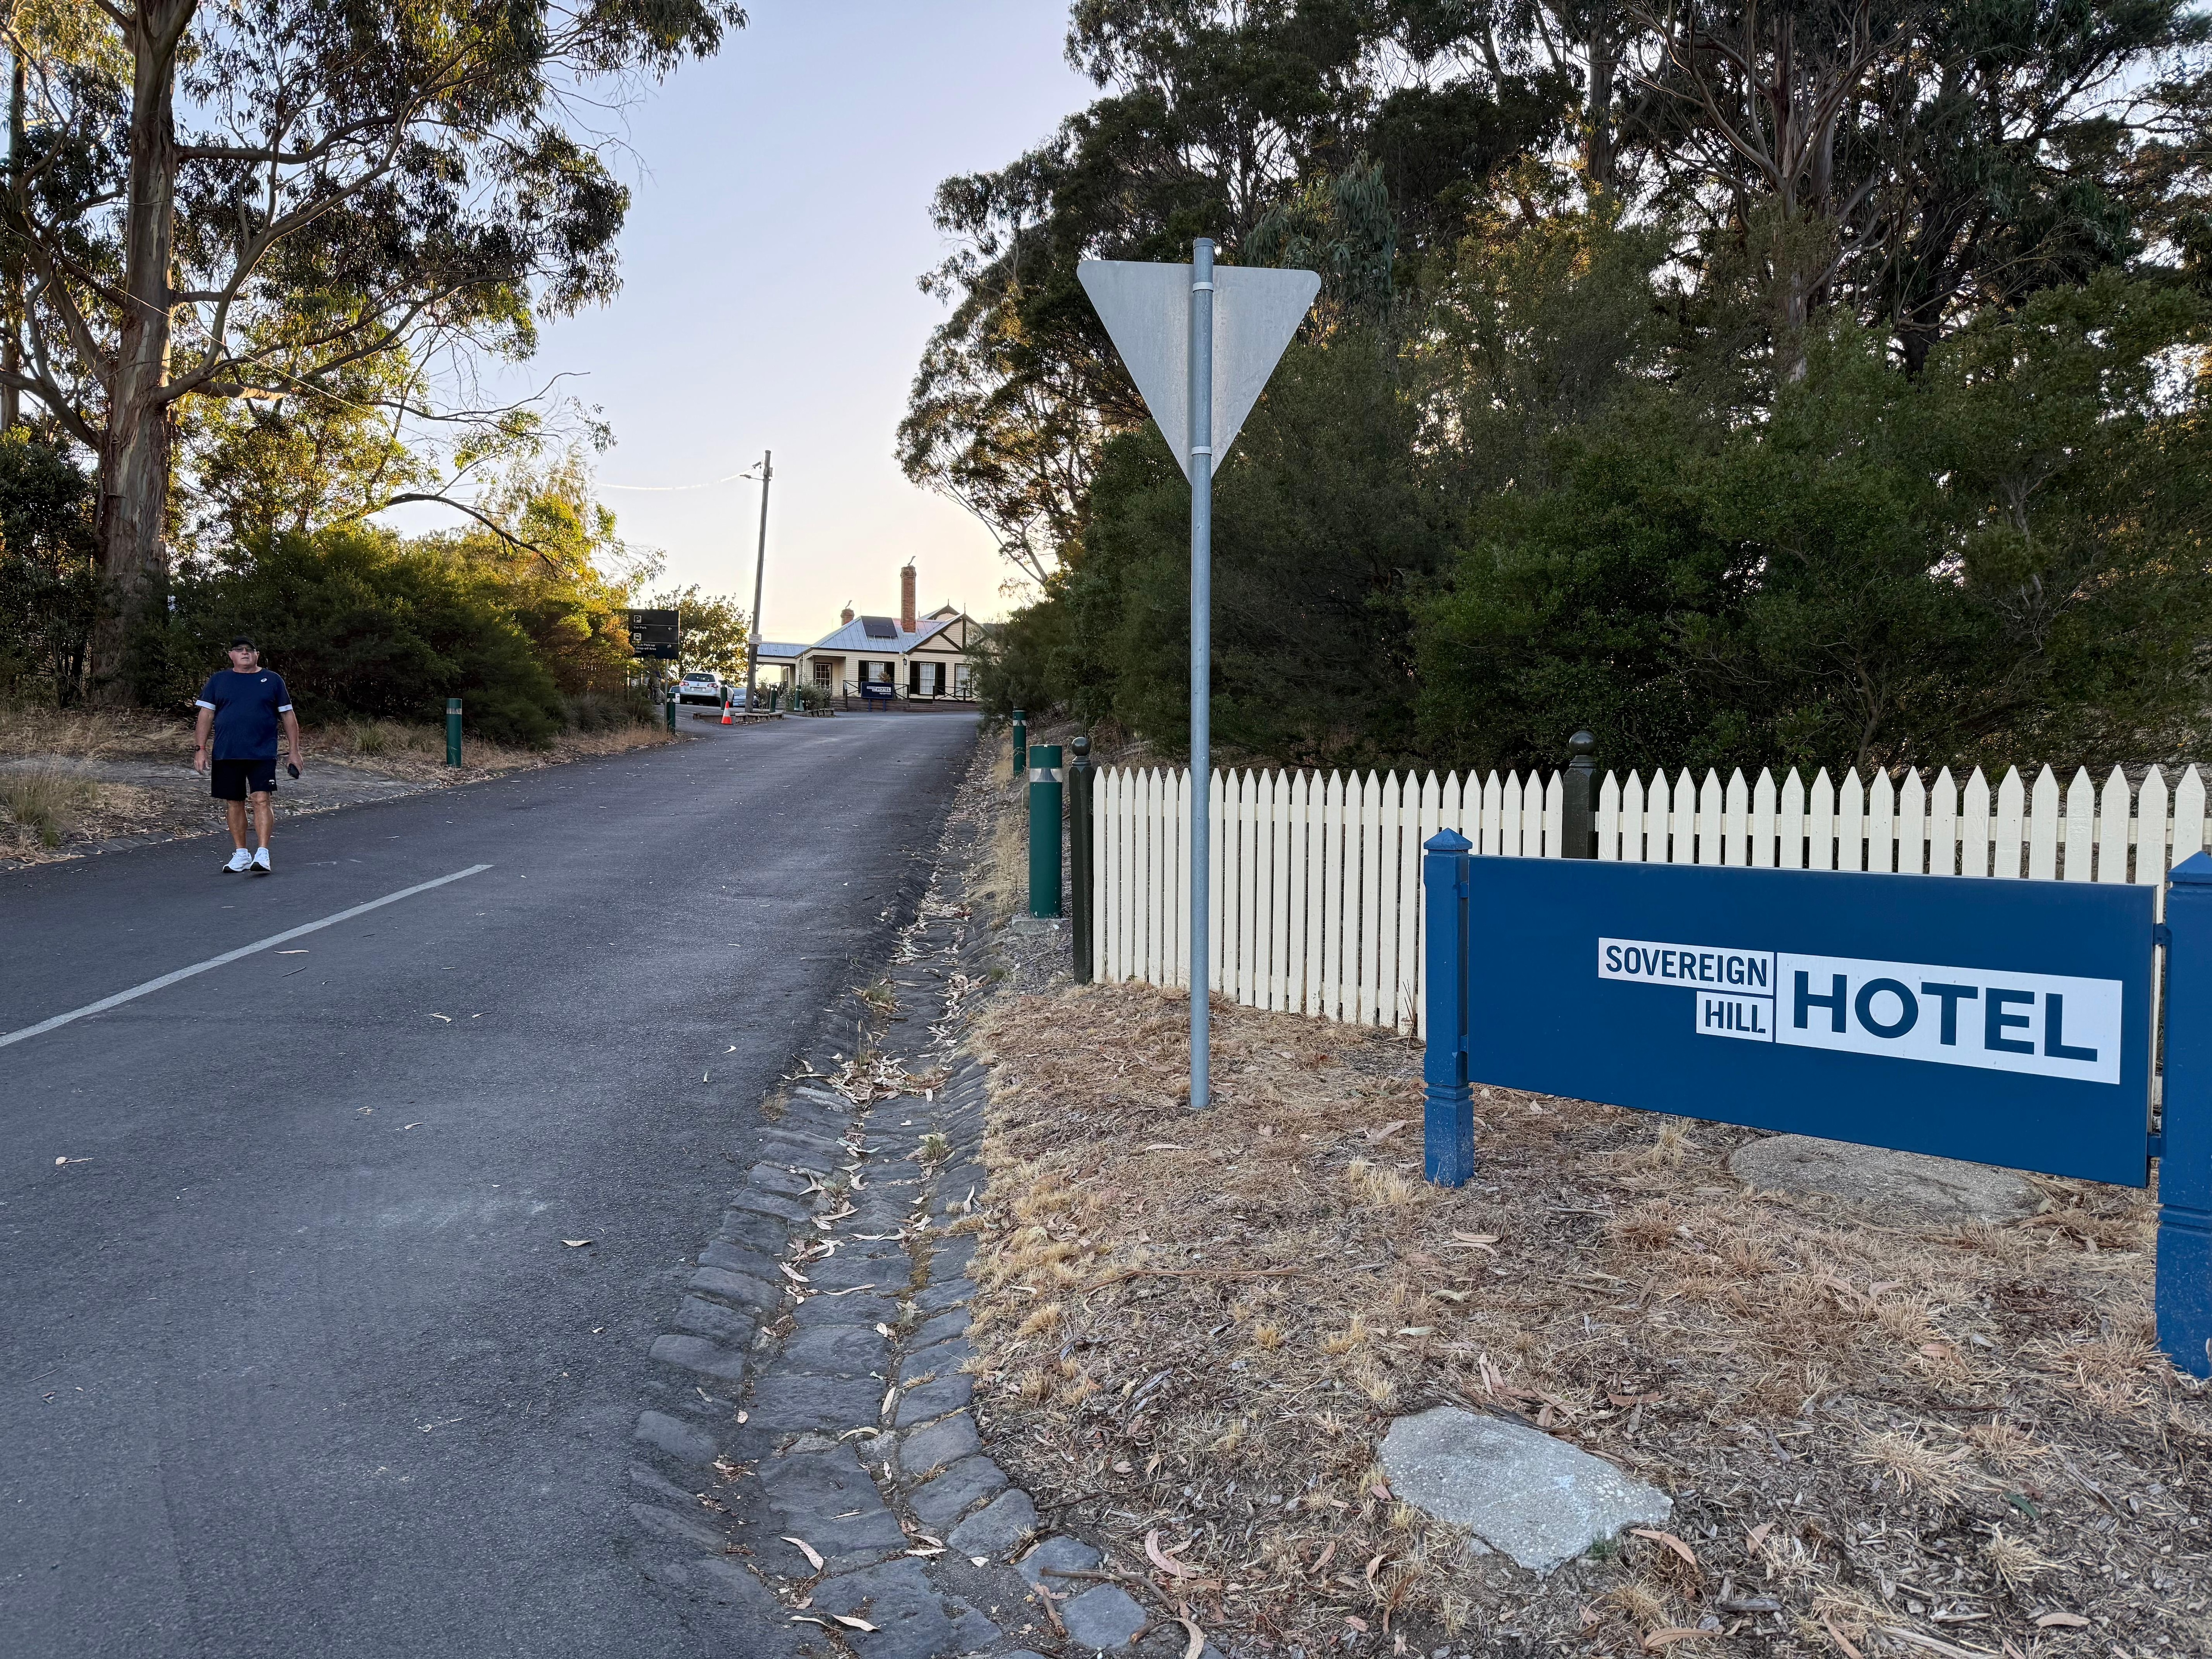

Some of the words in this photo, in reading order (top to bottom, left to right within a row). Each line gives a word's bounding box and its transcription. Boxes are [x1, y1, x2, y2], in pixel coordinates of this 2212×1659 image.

[1606, 945, 1767, 987] SOVEREIGN
[1705, 1000, 1766, 1033] HILL
[1793, 970, 2097, 1062] HOTEL
